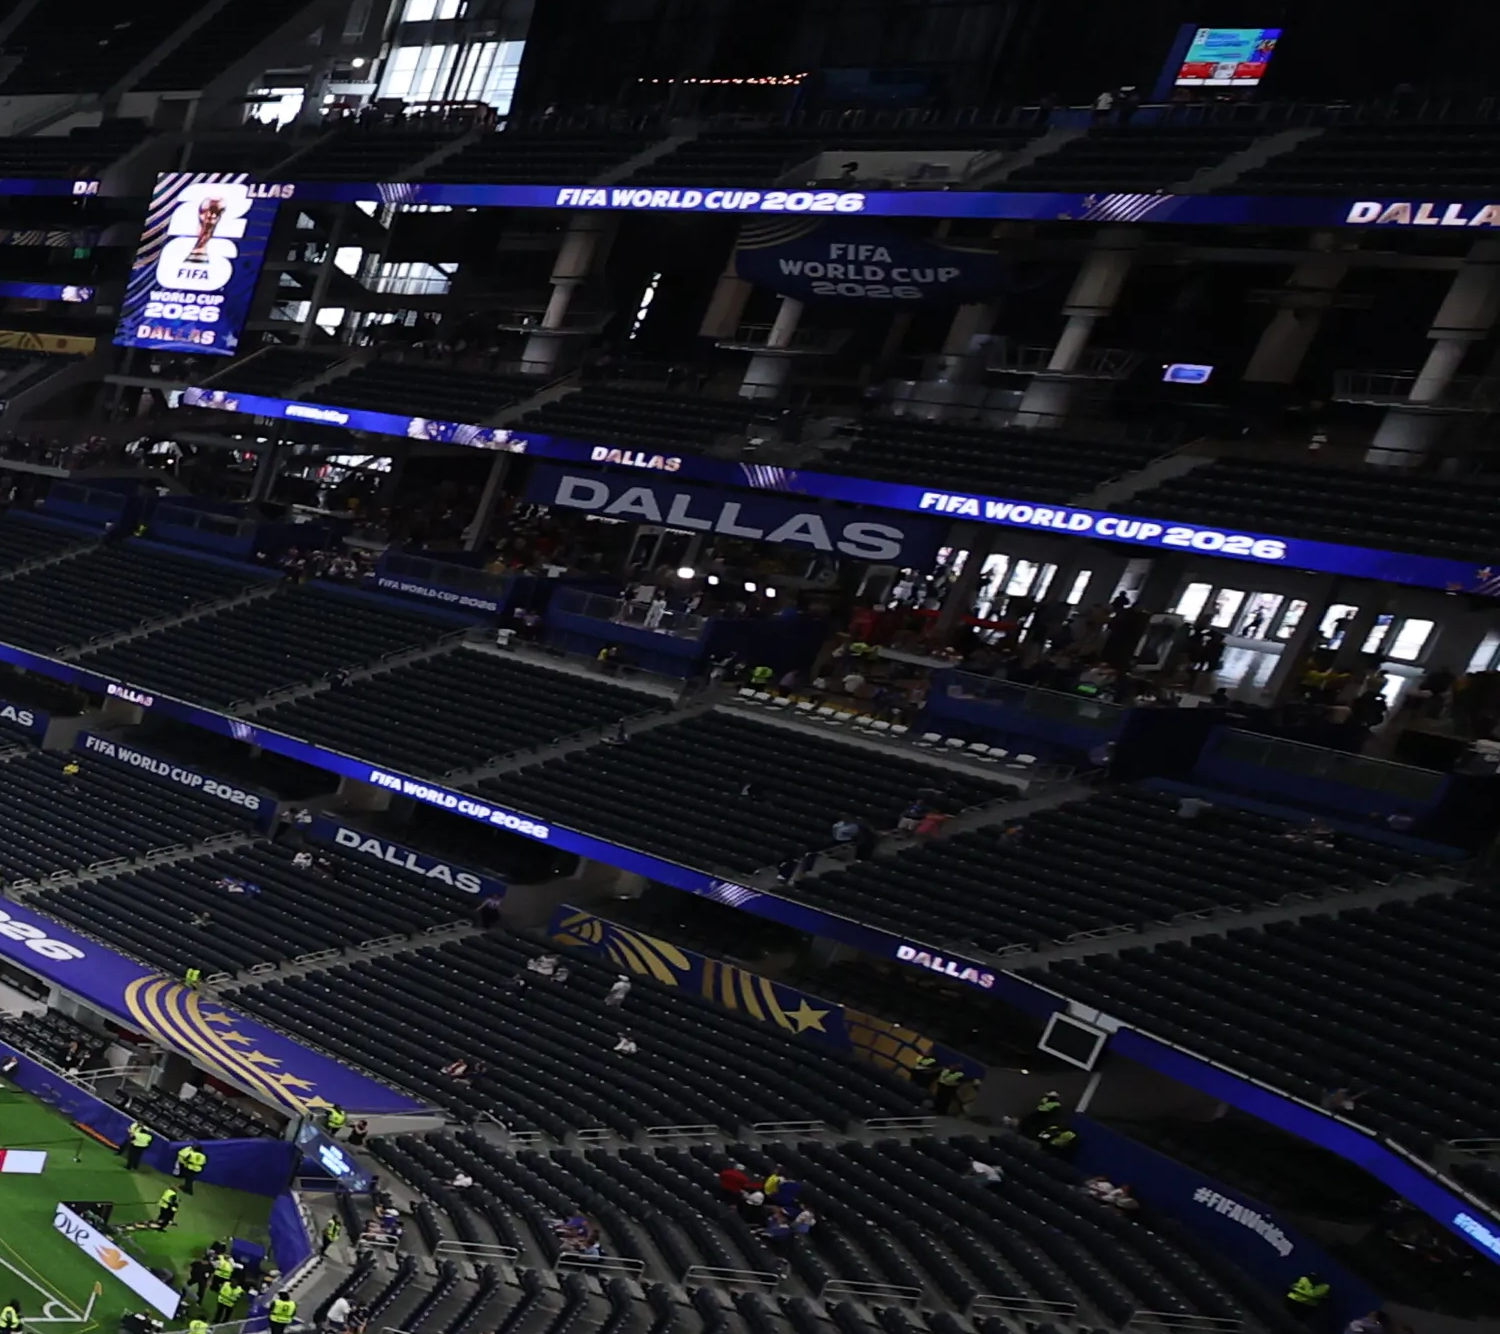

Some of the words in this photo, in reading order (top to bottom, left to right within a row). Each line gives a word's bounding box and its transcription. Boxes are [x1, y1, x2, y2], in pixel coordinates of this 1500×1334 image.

[556, 188, 608, 207] FIFA
[611, 189, 702, 209] WORLD
[704, 191, 761, 210] CUP
[760, 192, 865, 212] 2026
[829, 243, 892, 263] FIFA
[177, 269, 210, 280] FIFA
[779, 258, 885, 281] WORLD
[891, 267, 959, 283] CUP
[150, 291, 195, 304] WORLD
[195, 293, 225, 306] CUP
[811, 281, 923, 298] 2026
[143, 302, 220, 323] 2026
[136, 324, 216, 345] DALLAS
[590, 446, 682, 472] DALLAS
[555, 476, 904, 561] DALLAS
[919, 491, 980, 516] FIFA
[985, 501, 1093, 531] WORLD
[1095, 517, 1162, 540] CUP
[1161, 527, 1286, 560] 2026
[107, 683, 154, 707] DALLAS
[85, 735, 115, 757] FIFA
[117, 746, 170, 777] WORLD
[170, 767, 203, 789] CUP
[202, 778, 260, 810] 2026
[369, 770, 402, 793] FIFA
[402, 780, 457, 809] WORLD
[457, 798, 491, 822] CUP
[490, 808, 550, 838] 2026
[334, 827, 482, 895] DALLAS
[896, 945, 995, 989] DALLAS
